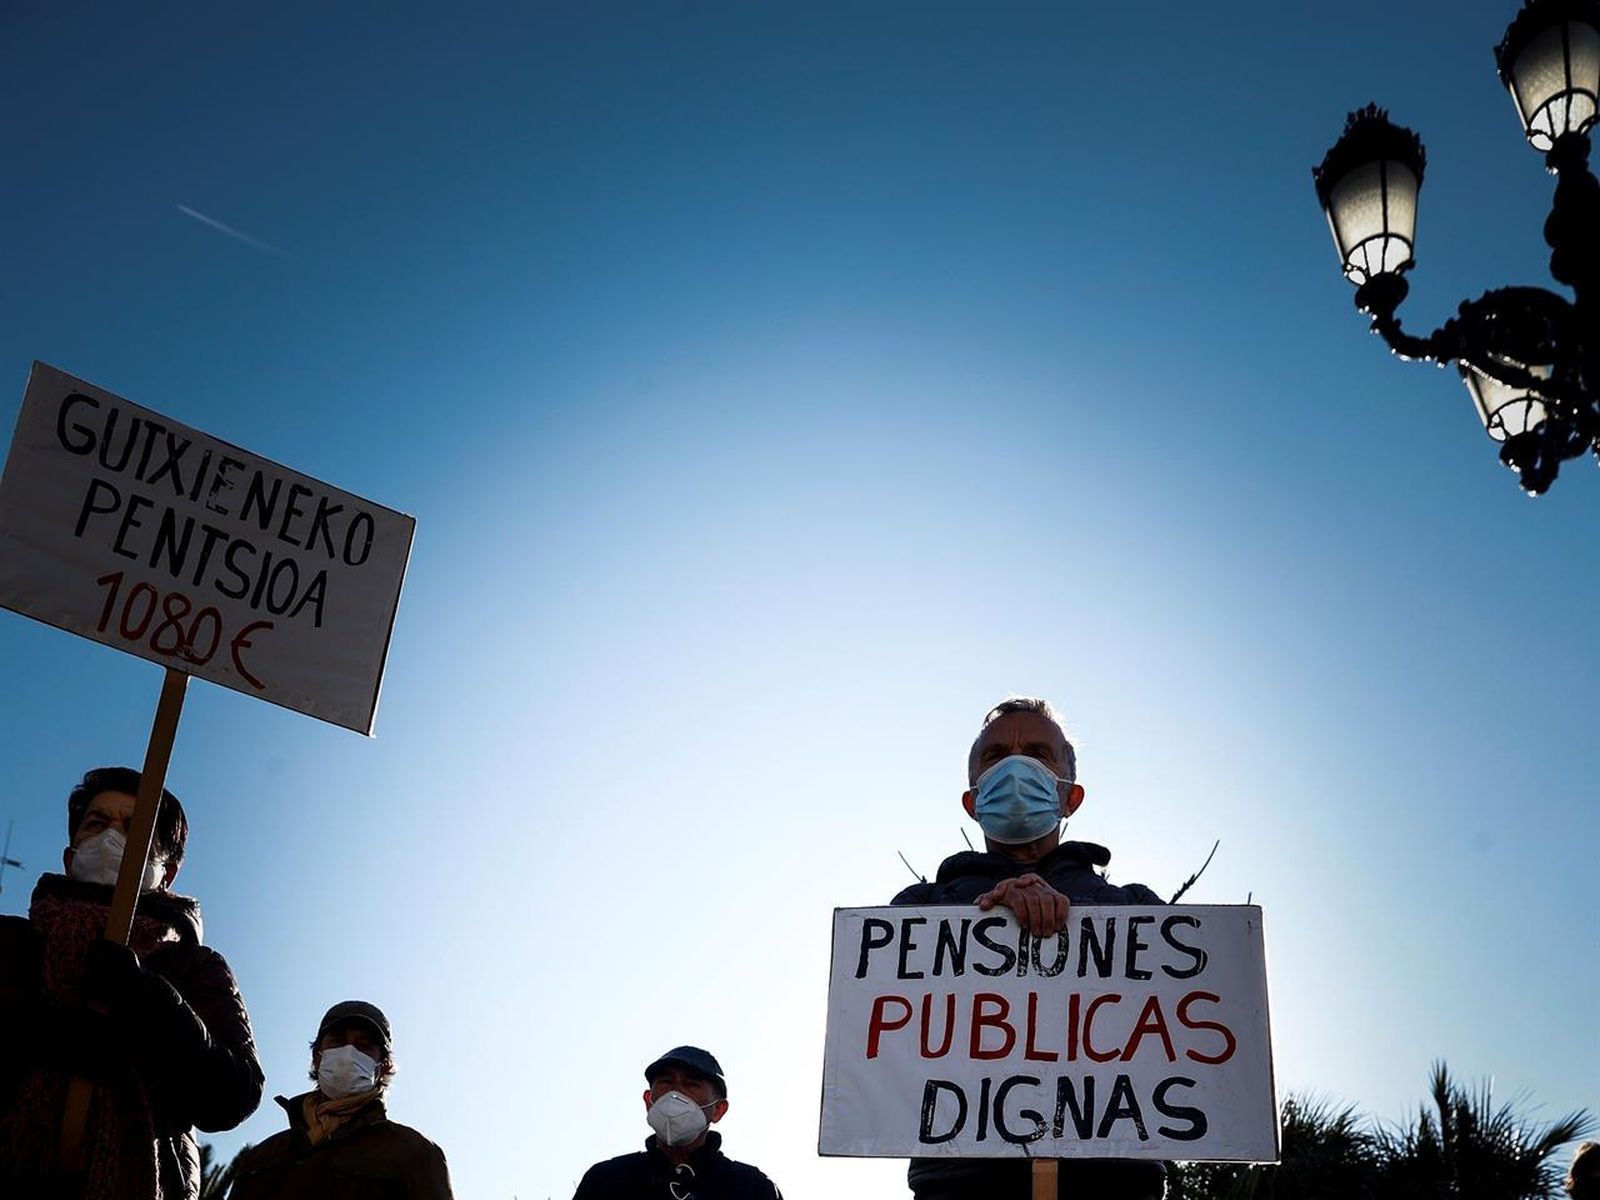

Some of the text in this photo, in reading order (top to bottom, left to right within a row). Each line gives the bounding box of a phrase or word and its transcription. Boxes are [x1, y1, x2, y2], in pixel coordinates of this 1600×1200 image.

[56, 393, 374, 566] GUTXIENEKO
[75, 478, 327, 628] PENTSIOA
[855, 916, 1208, 980] PENSIONES
[866, 991, 1236, 1064] PUBLICAS
[918, 1074, 1208, 1143] DIGNAS
